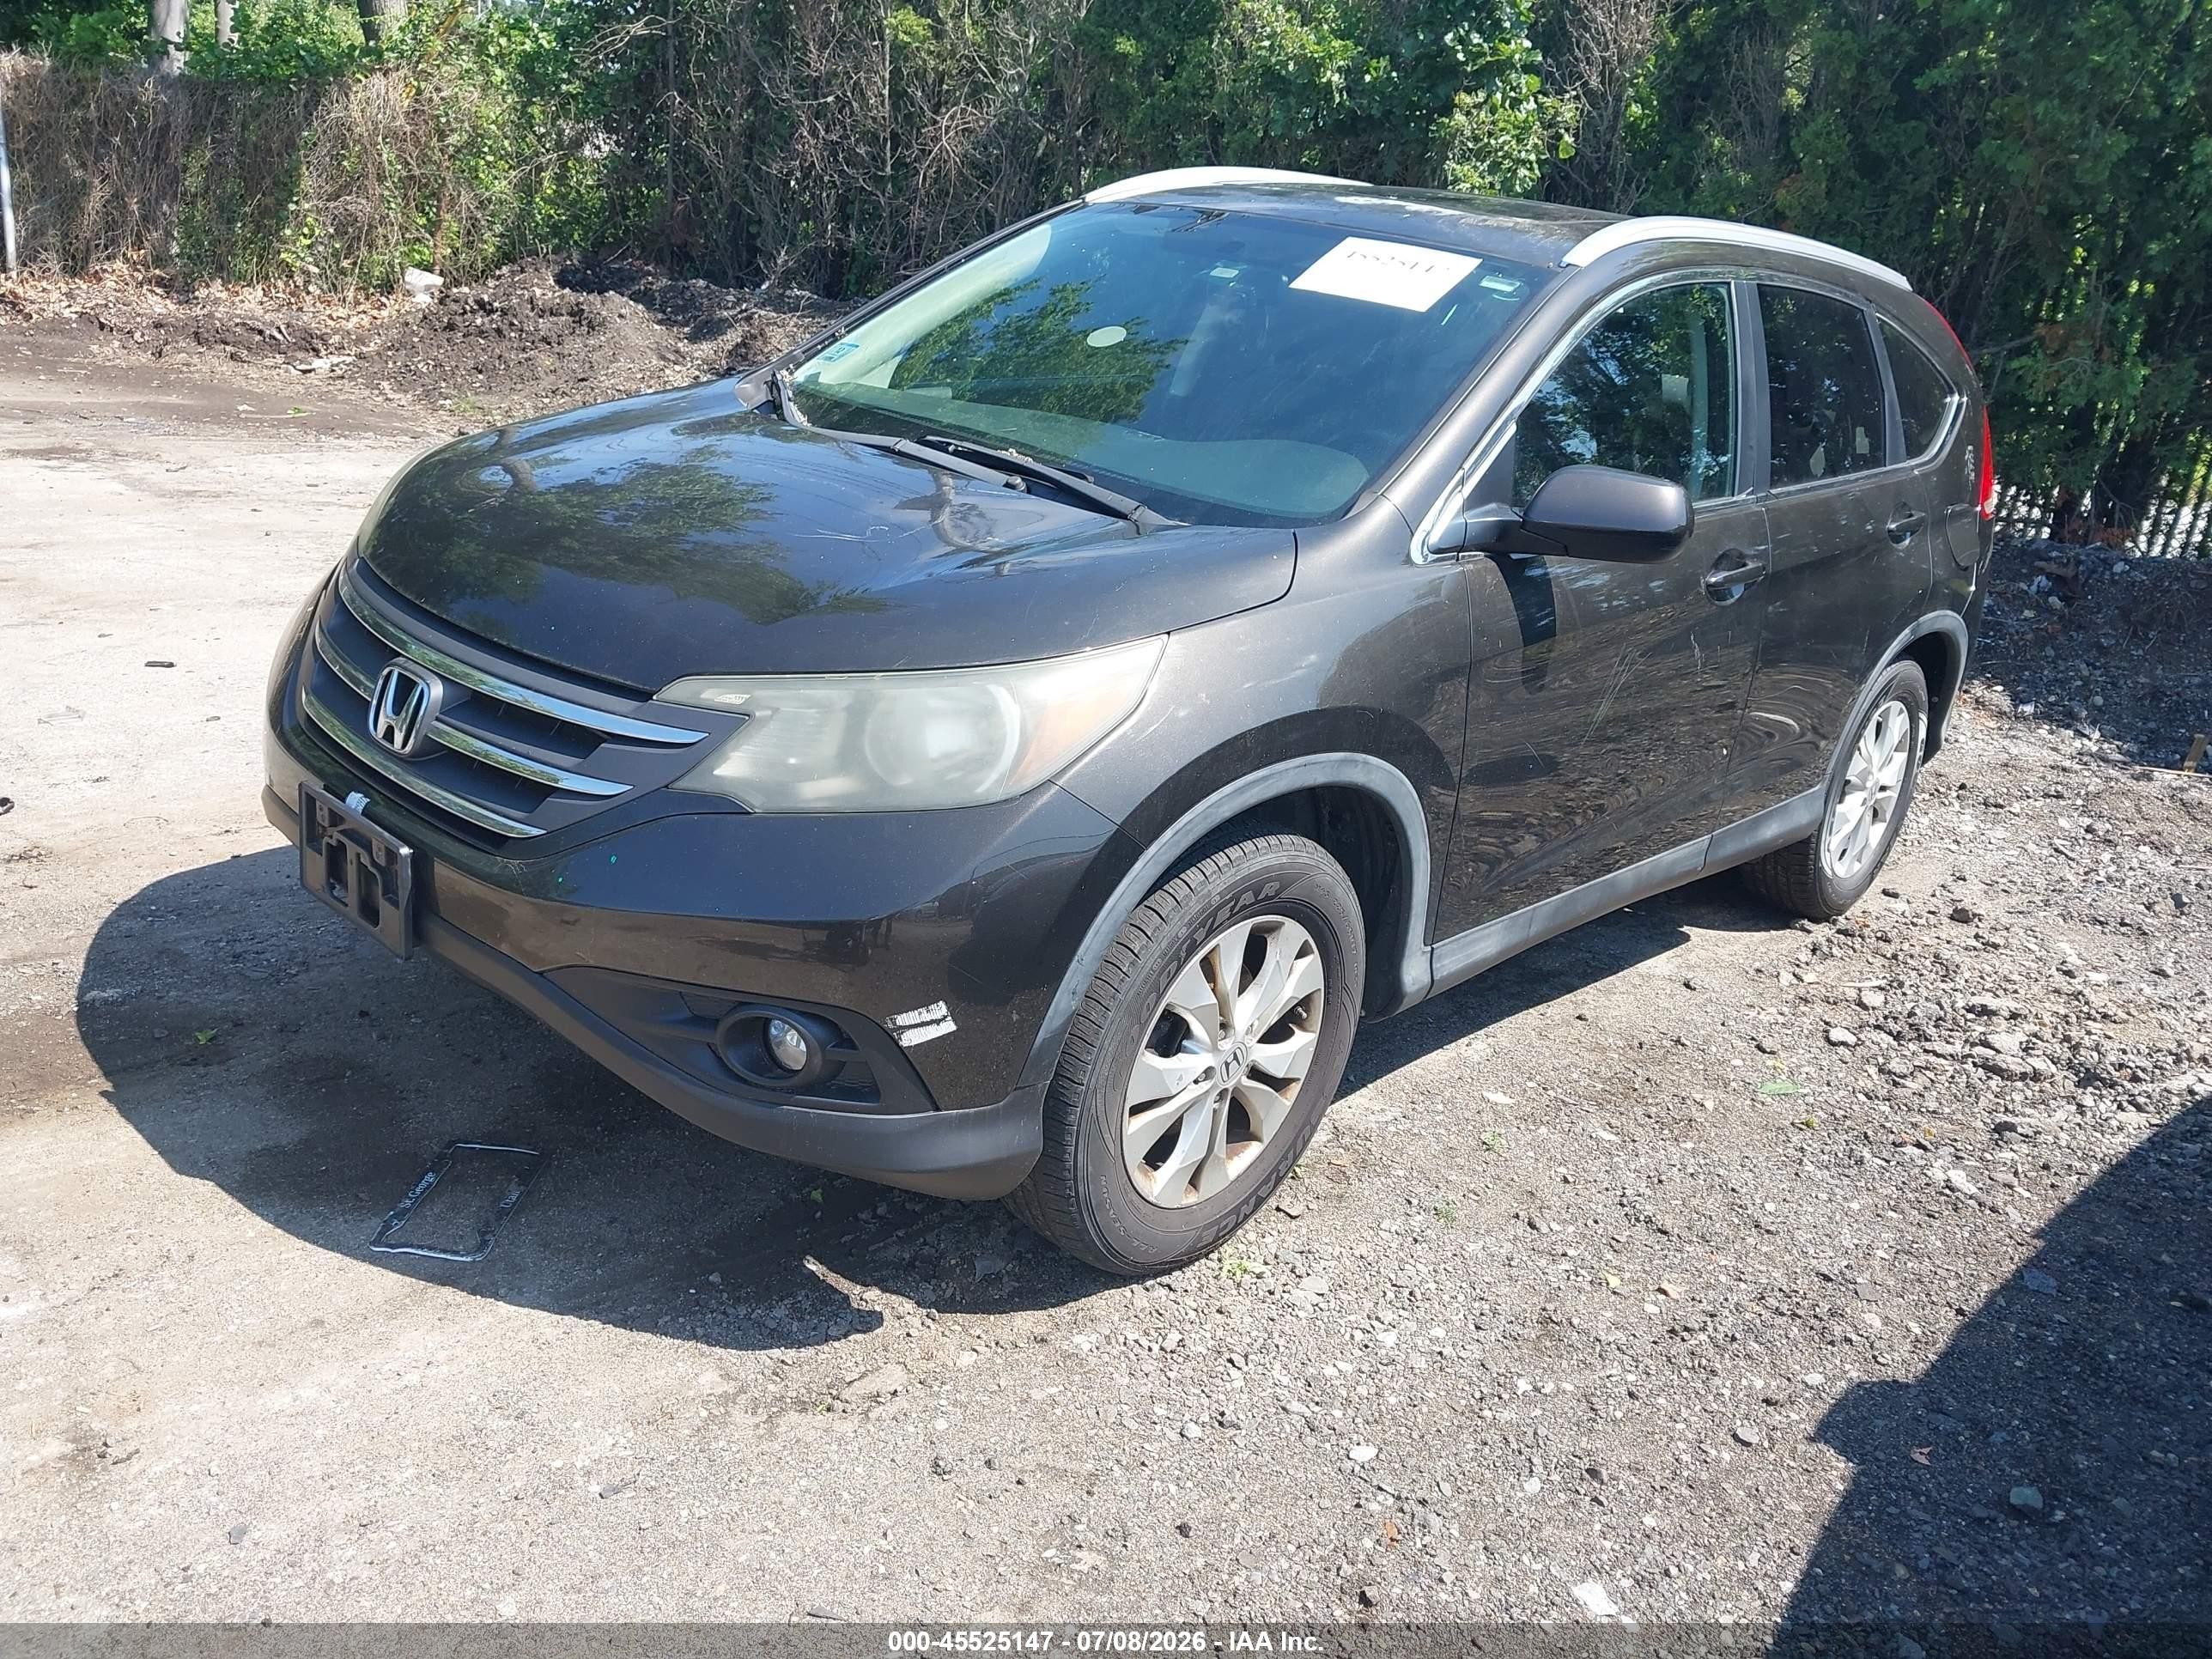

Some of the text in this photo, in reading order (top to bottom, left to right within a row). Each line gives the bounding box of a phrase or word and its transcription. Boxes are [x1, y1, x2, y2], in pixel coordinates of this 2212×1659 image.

[399, 1172, 435, 1209] St. George
[1099, 1175, 1158, 1254] ALL-SEASON
